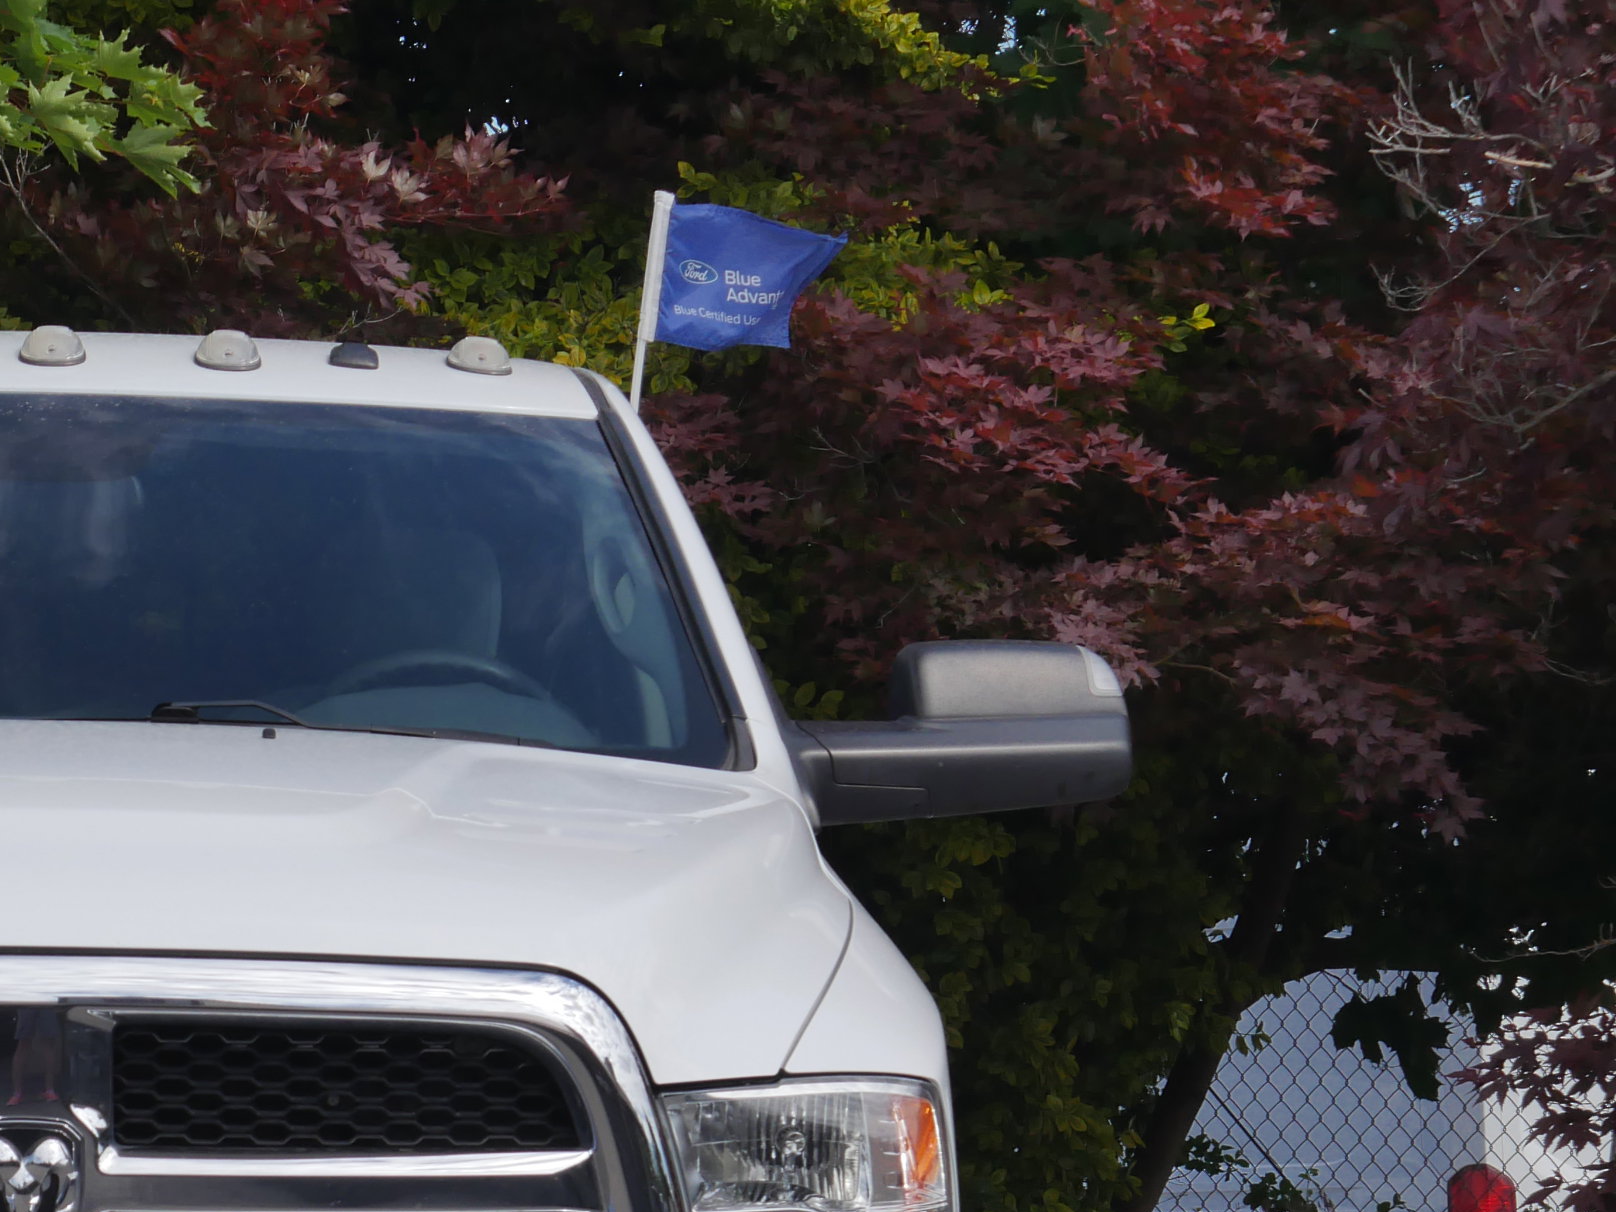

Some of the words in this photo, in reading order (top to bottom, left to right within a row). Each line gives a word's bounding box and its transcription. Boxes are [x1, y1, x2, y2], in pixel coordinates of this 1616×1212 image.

[684, 262, 708, 281] Ford
[724, 270, 761, 287] Blue
[673, 304, 697, 317] Blue
[698, 308, 741, 325] Certified
